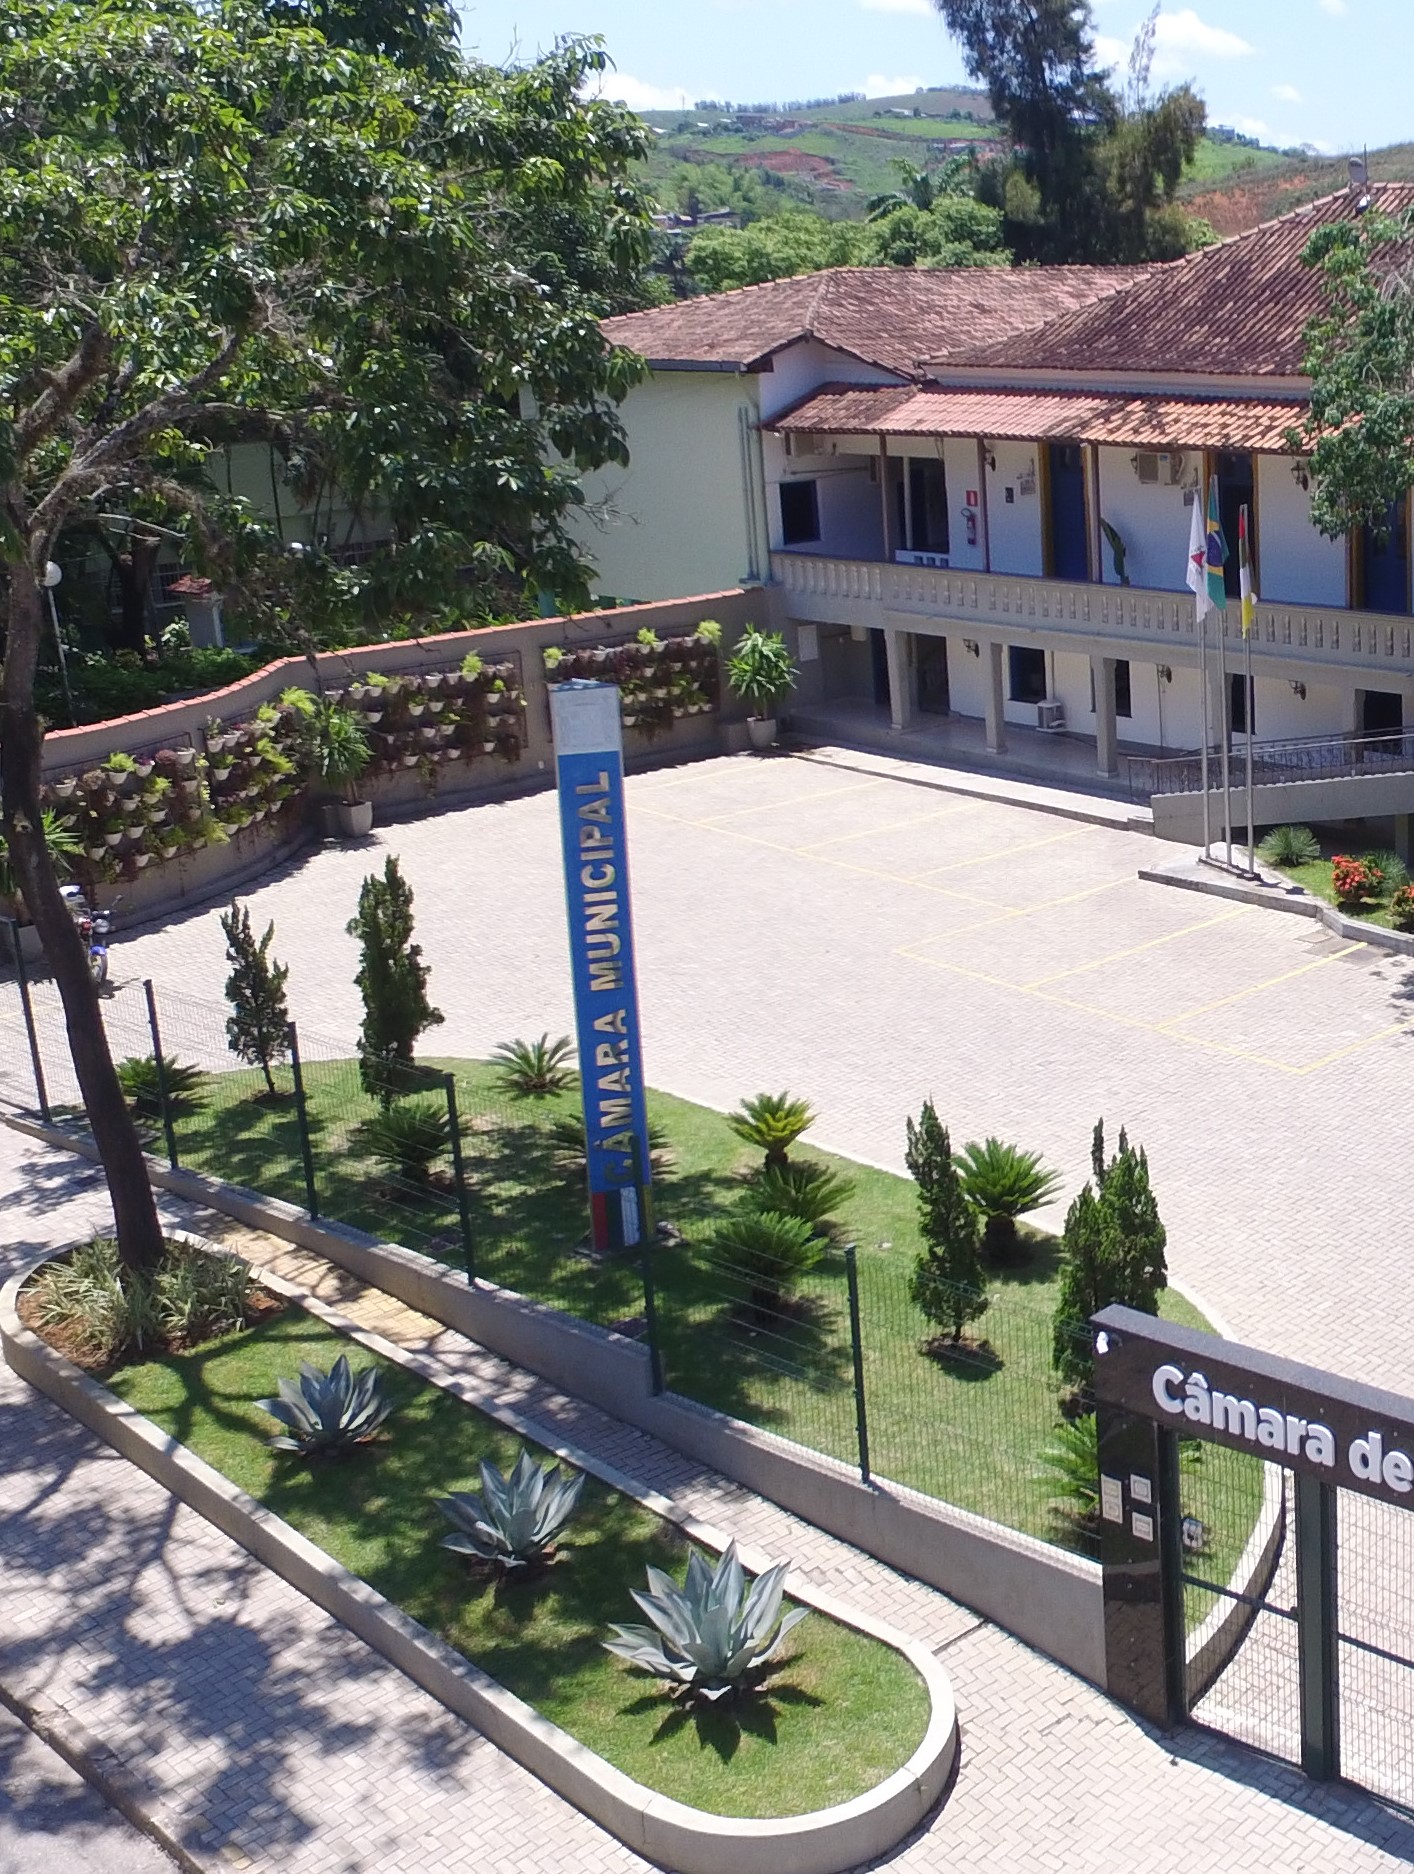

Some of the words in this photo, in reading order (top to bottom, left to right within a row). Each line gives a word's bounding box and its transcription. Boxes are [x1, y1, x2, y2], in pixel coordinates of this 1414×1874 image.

[576, 771, 625, 991] MUNICIPAL
[593, 1009, 635, 1182] CÂMARA
[1152, 1363, 1337, 1467] Câmara
